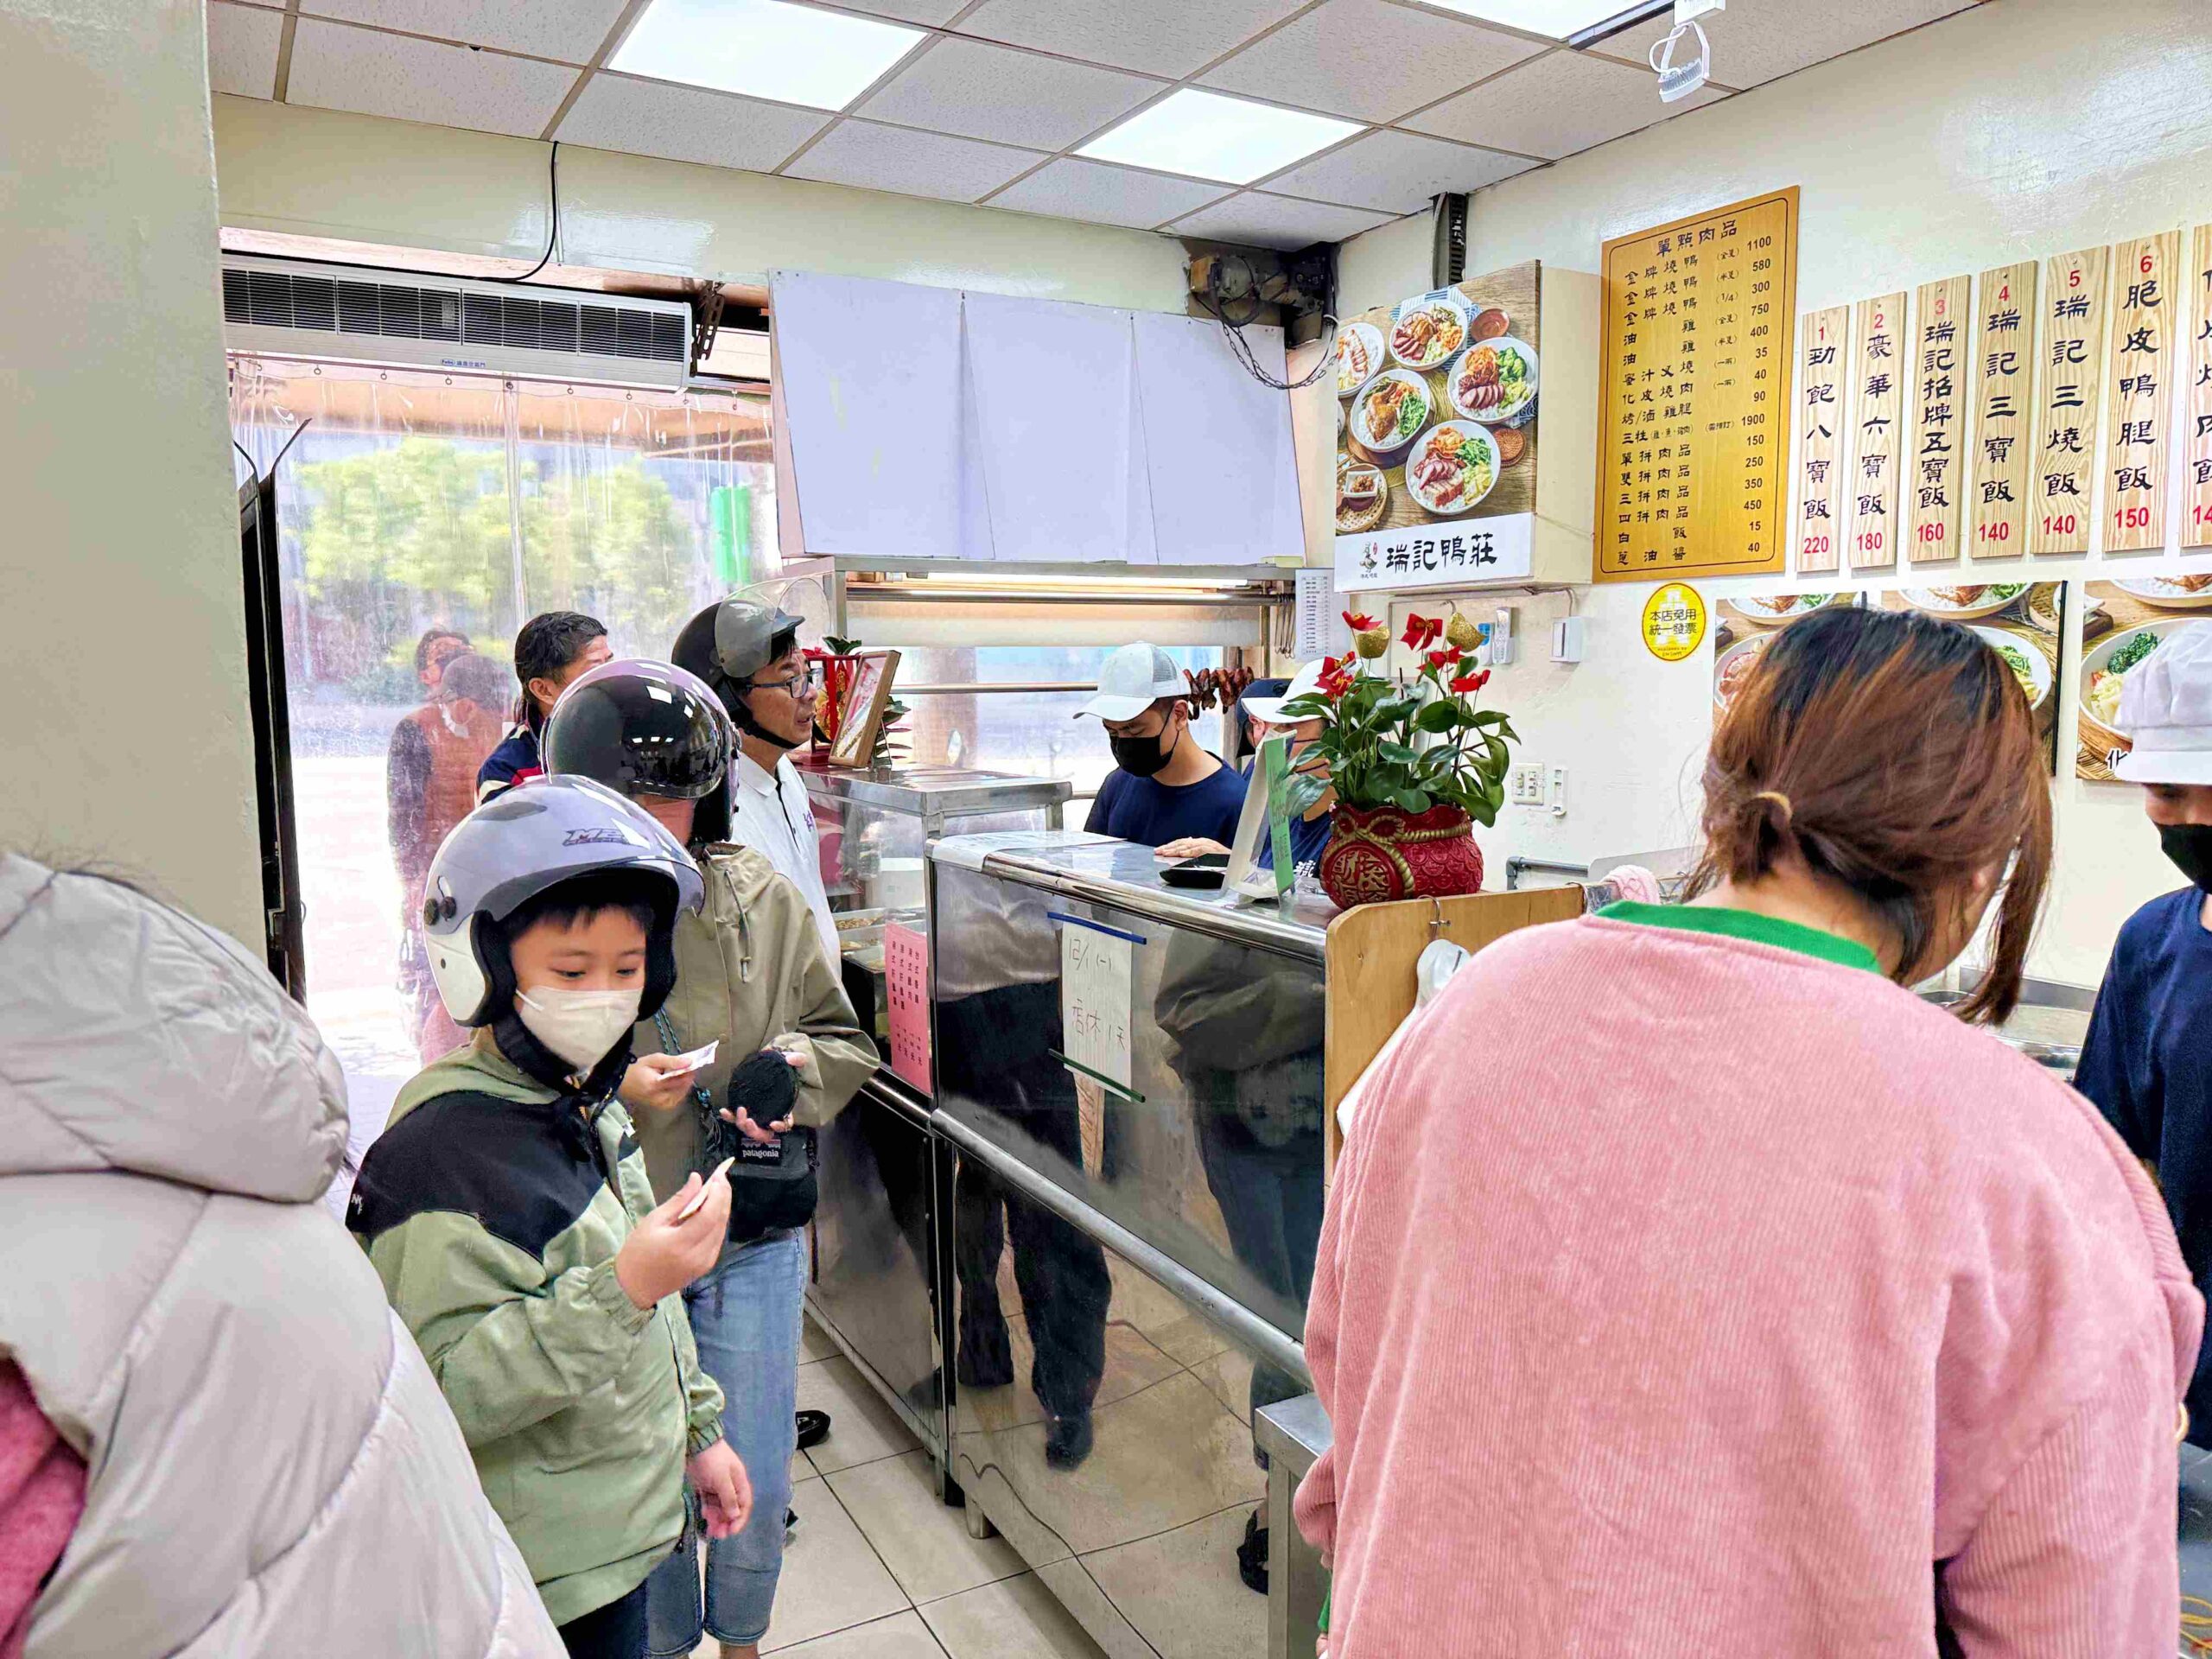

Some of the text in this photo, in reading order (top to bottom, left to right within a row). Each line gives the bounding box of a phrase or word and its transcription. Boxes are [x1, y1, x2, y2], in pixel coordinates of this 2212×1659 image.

[1656, 219, 1737, 257] 單點肉品
[1624, 254, 1698, 285] 金牌燒鴨
[1747, 236, 1771, 251] 1100
[2139, 255, 2152, 273] 6
[1624, 276, 1698, 306] 金牌燒鴨
[1752, 258, 1770, 272] 580
[2069, 270, 2081, 287] 5
[1624, 296, 1697, 327] 金牌燒鴨
[1751, 280, 1770, 295] 300
[1999, 286, 2010, 302] 4
[1751, 302, 1770, 317] 750
[1934, 299, 1946, 315] 3
[1873, 314, 1884, 329] 2
[1750, 325, 1769, 338] 400
[1817, 326, 1825, 341] 1
[1755, 346, 1768, 359] 35
[1622, 382, 1694, 405] 化皮燒肉
[1754, 368, 1767, 381] 40
[2044, 294, 2090, 497] 瑞記三燒飯
[1753, 391, 1766, 403] 90
[1980, 308, 2021, 503] 瑞記三寶飯
[1741, 414, 1765, 426] 1900
[1918, 320, 1955, 508] 瑞記招牌五寶飯
[1857, 334, 1893, 516] 豪華六寶飯
[1620, 434, 1764, 467] 單拼肉品 150
[1620, 455, 1764, 487] 雙拼肉品 250
[1619, 477, 1763, 505] 三拼肉品 350
[1618, 499, 1762, 524] 四拼肉品 450
[2113, 507, 2150, 528] 150
[1749, 520, 1761, 532] 15
[1916, 523, 1944, 543] 160
[1979, 521, 2009, 543] 140
[2043, 514, 2075, 536] 140
[1747, 541, 1760, 553] 40
[1803, 536, 1829, 554] 220
[1856, 531, 1883, 550] 180
[1386, 532, 1497, 573] 瑞記鴨莊
[1649, 608, 1697, 622] 本店免用
[1649, 622, 1697, 636] 統一發票
[742, 1149, 779, 1159] patagonia
